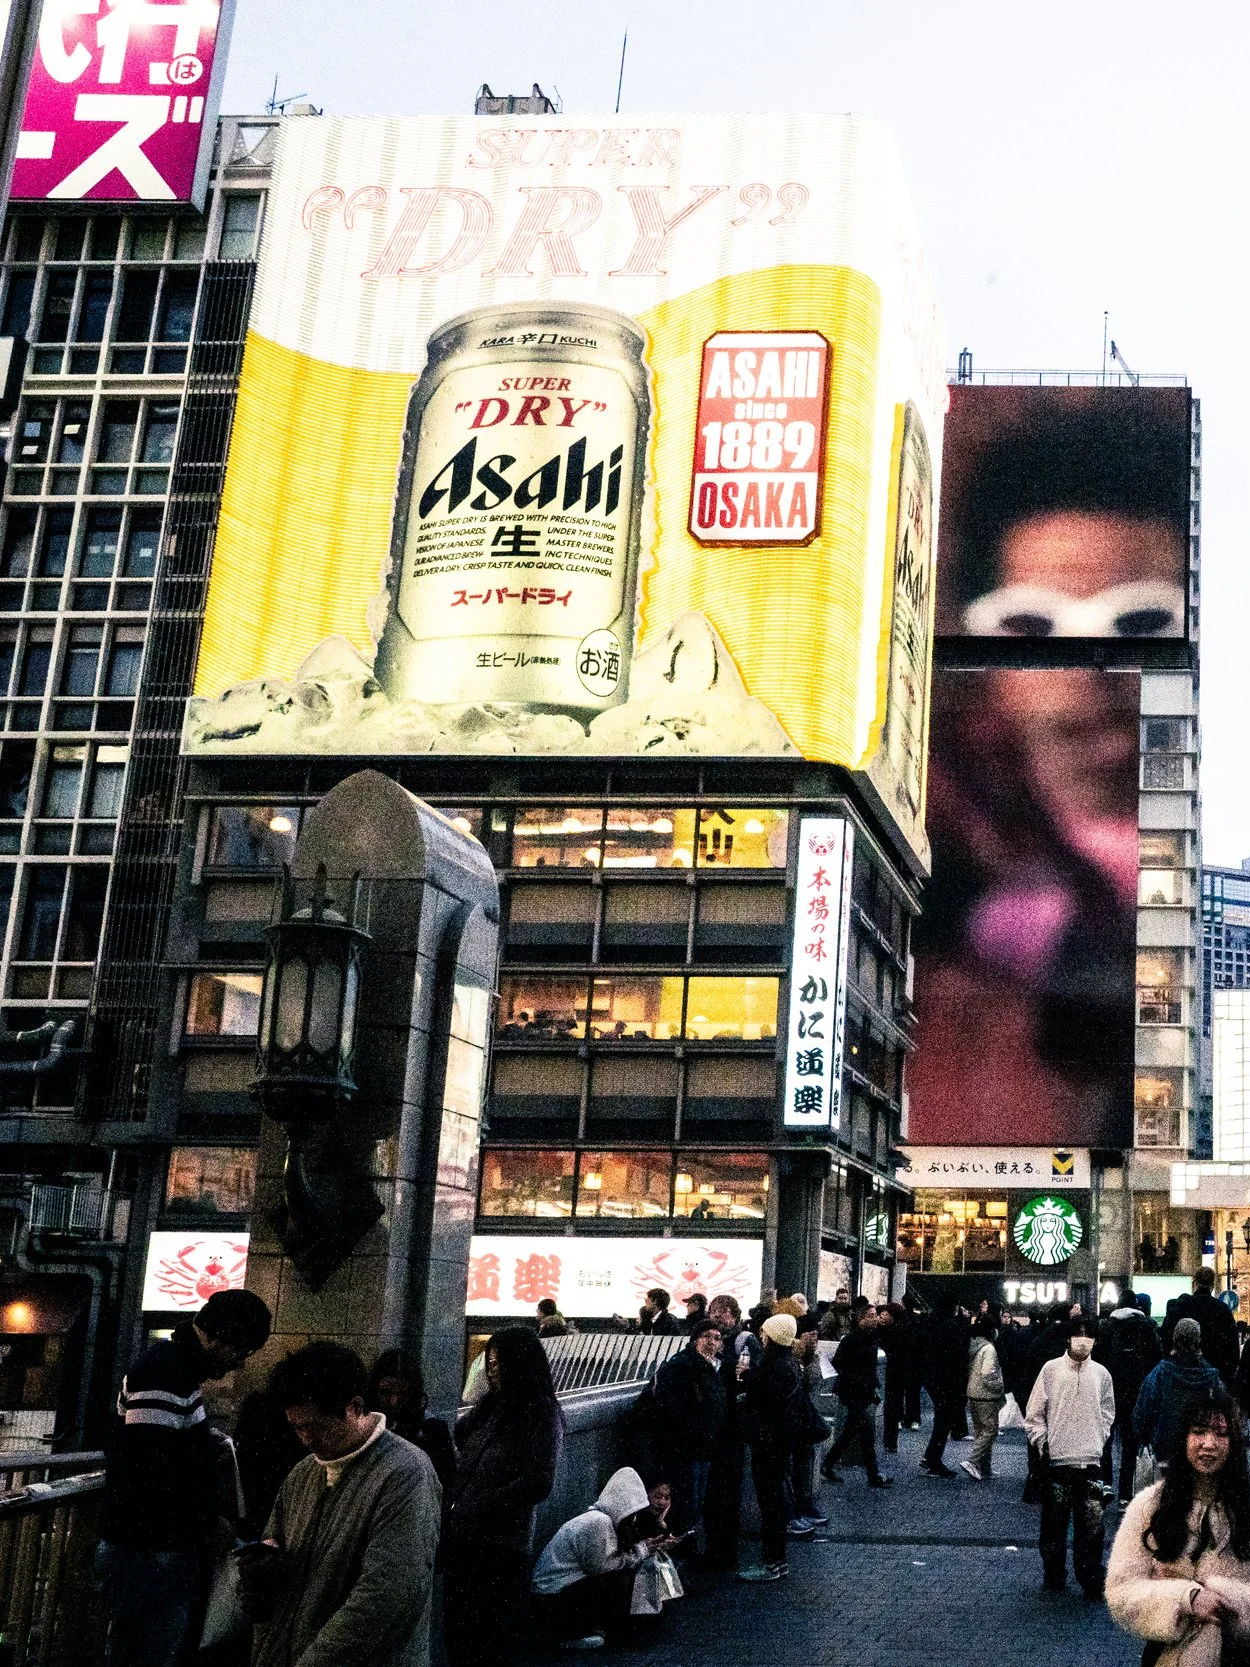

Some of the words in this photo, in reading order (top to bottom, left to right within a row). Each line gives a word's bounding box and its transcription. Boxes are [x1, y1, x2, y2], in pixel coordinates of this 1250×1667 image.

[465, 128, 681, 169] SUPER
[517, 332, 559, 345] 辛口
[559, 335, 598, 348] KUCHI
[705, 350, 820, 398] ASAHI
[498, 377, 572, 392] SUPER
[734, 401, 787, 421] since
[701, 421, 816, 470] 1889
[419, 436, 624, 519] Asahi
[697, 481, 809, 530] OSAKA
[438, 518, 460, 527] SUPER
[463, 516, 479, 524] DRY
[489, 514, 524, 522] BREWED
[526, 514, 548, 522] WITH
[550, 515, 590, 525] PRECISION
[591, 519, 601, 528] TO
[491, 524, 541, 557] 生
[547, 526, 577, 536] UNDER
[579, 529, 592, 538] THE
[446, 539, 485, 549] JAPANESE
[546, 539, 582, 548] MASTER
[463, 562, 487, 571] CRISP
[487, 561, 514, 569] TASTE
[514, 561, 535, 569] AND
[565, 564, 591, 574] CLEAN
[563, 551, 613, 565] TECHNIQUES
[451, 587, 573, 607] スーパードライ
[580, 648, 621, 682] お酒
[804, 866, 832, 962] 本場の味
[1005, 1280, 1120, 1303] TSUTA
